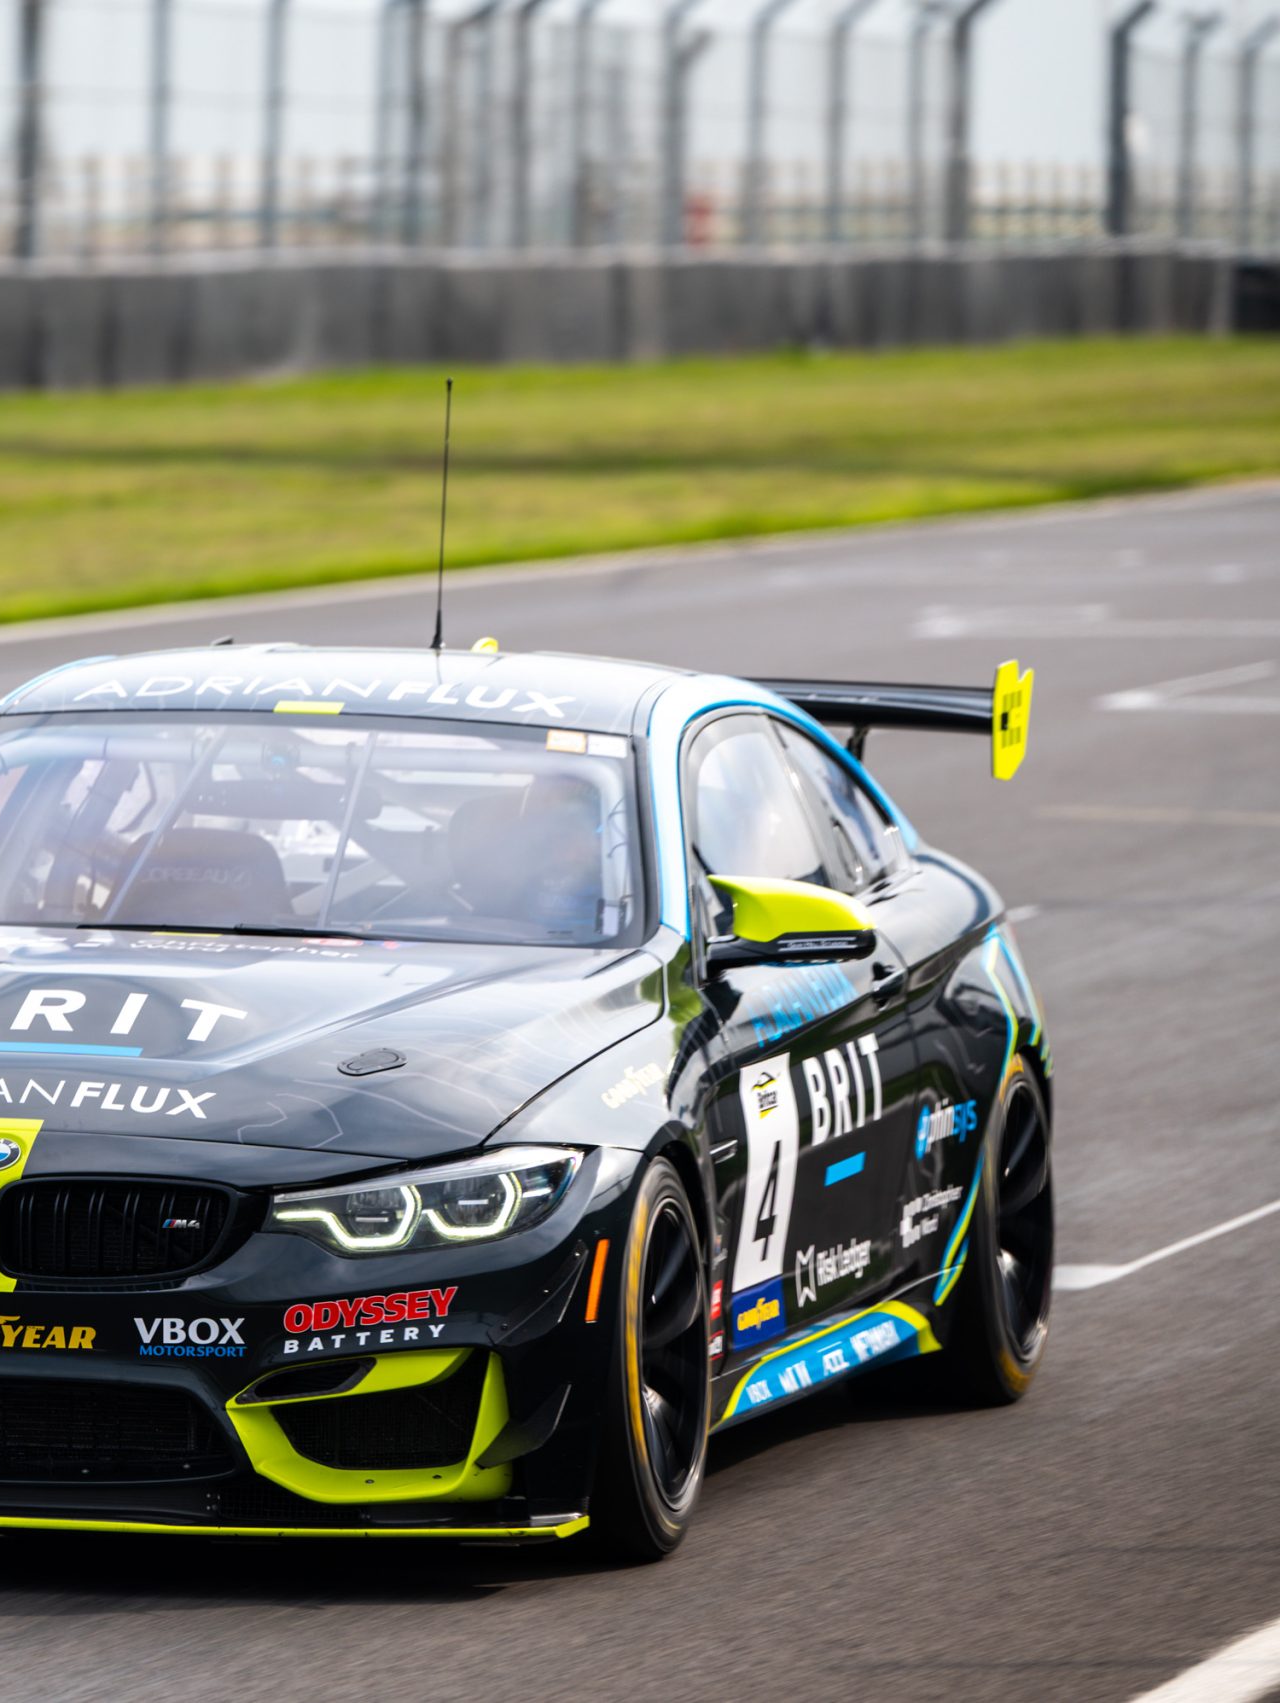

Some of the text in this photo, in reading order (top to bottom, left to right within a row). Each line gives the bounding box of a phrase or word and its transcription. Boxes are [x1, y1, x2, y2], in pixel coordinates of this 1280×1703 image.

[801, 1032, 883, 1147] BRIT
[752, 1140, 783, 1263] 4
[283, 1286, 458, 1334] ODYSSEY
[133, 1317, 245, 1345] VBOX
[284, 1323, 446, 1354] BATTERY
[139, 1344, 247, 1358] MOTORSPORT
